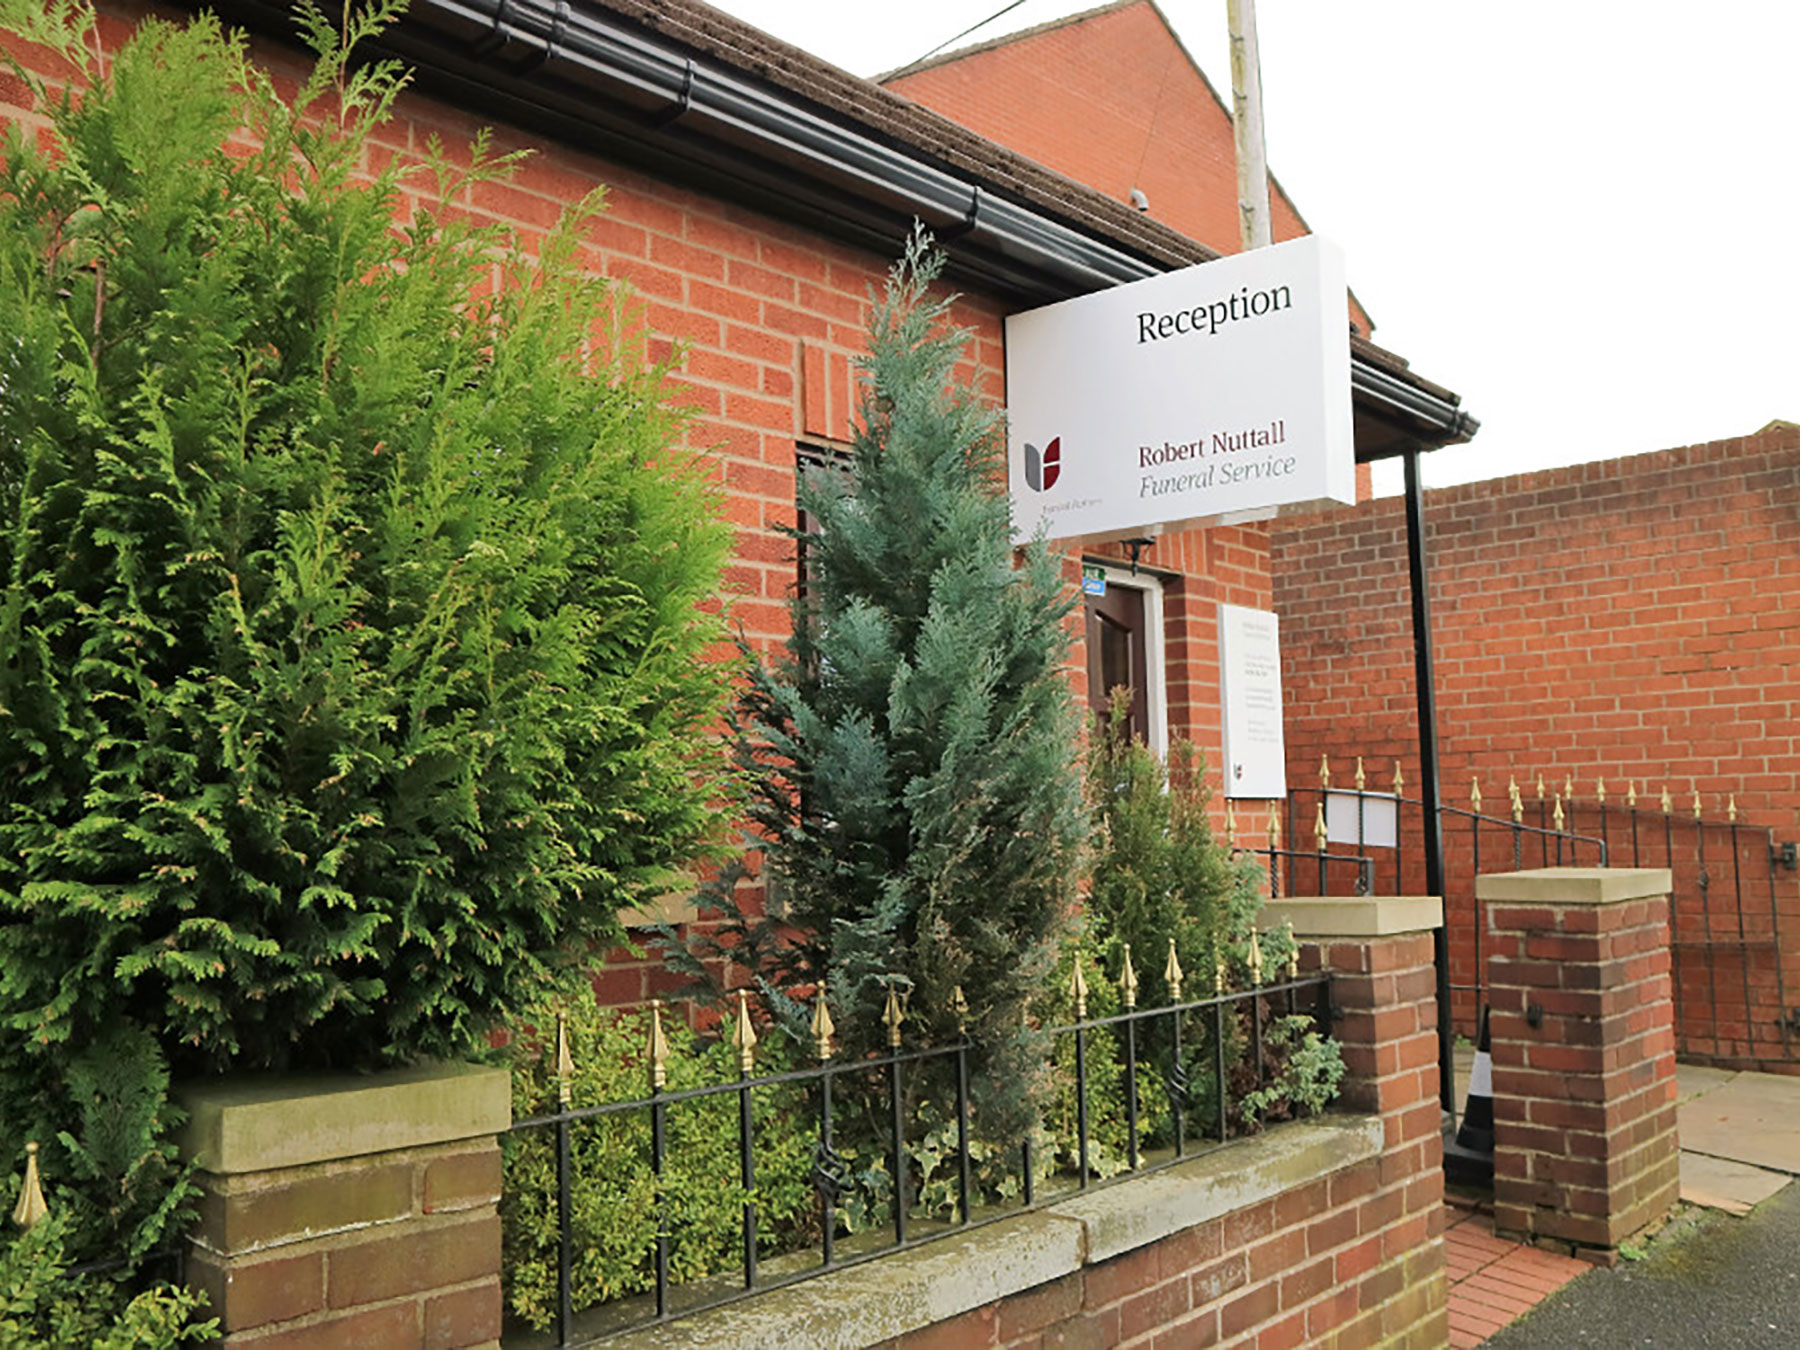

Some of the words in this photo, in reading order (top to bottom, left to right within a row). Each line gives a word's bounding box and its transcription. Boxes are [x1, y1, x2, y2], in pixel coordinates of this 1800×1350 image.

[1138, 285, 1291, 343] Reception
[1139, 440, 1205, 467] Robert
[1213, 421, 1286, 456] Nuttall
[1140, 465, 1214, 497] Funeral
[1220, 455, 1296, 485] Service
